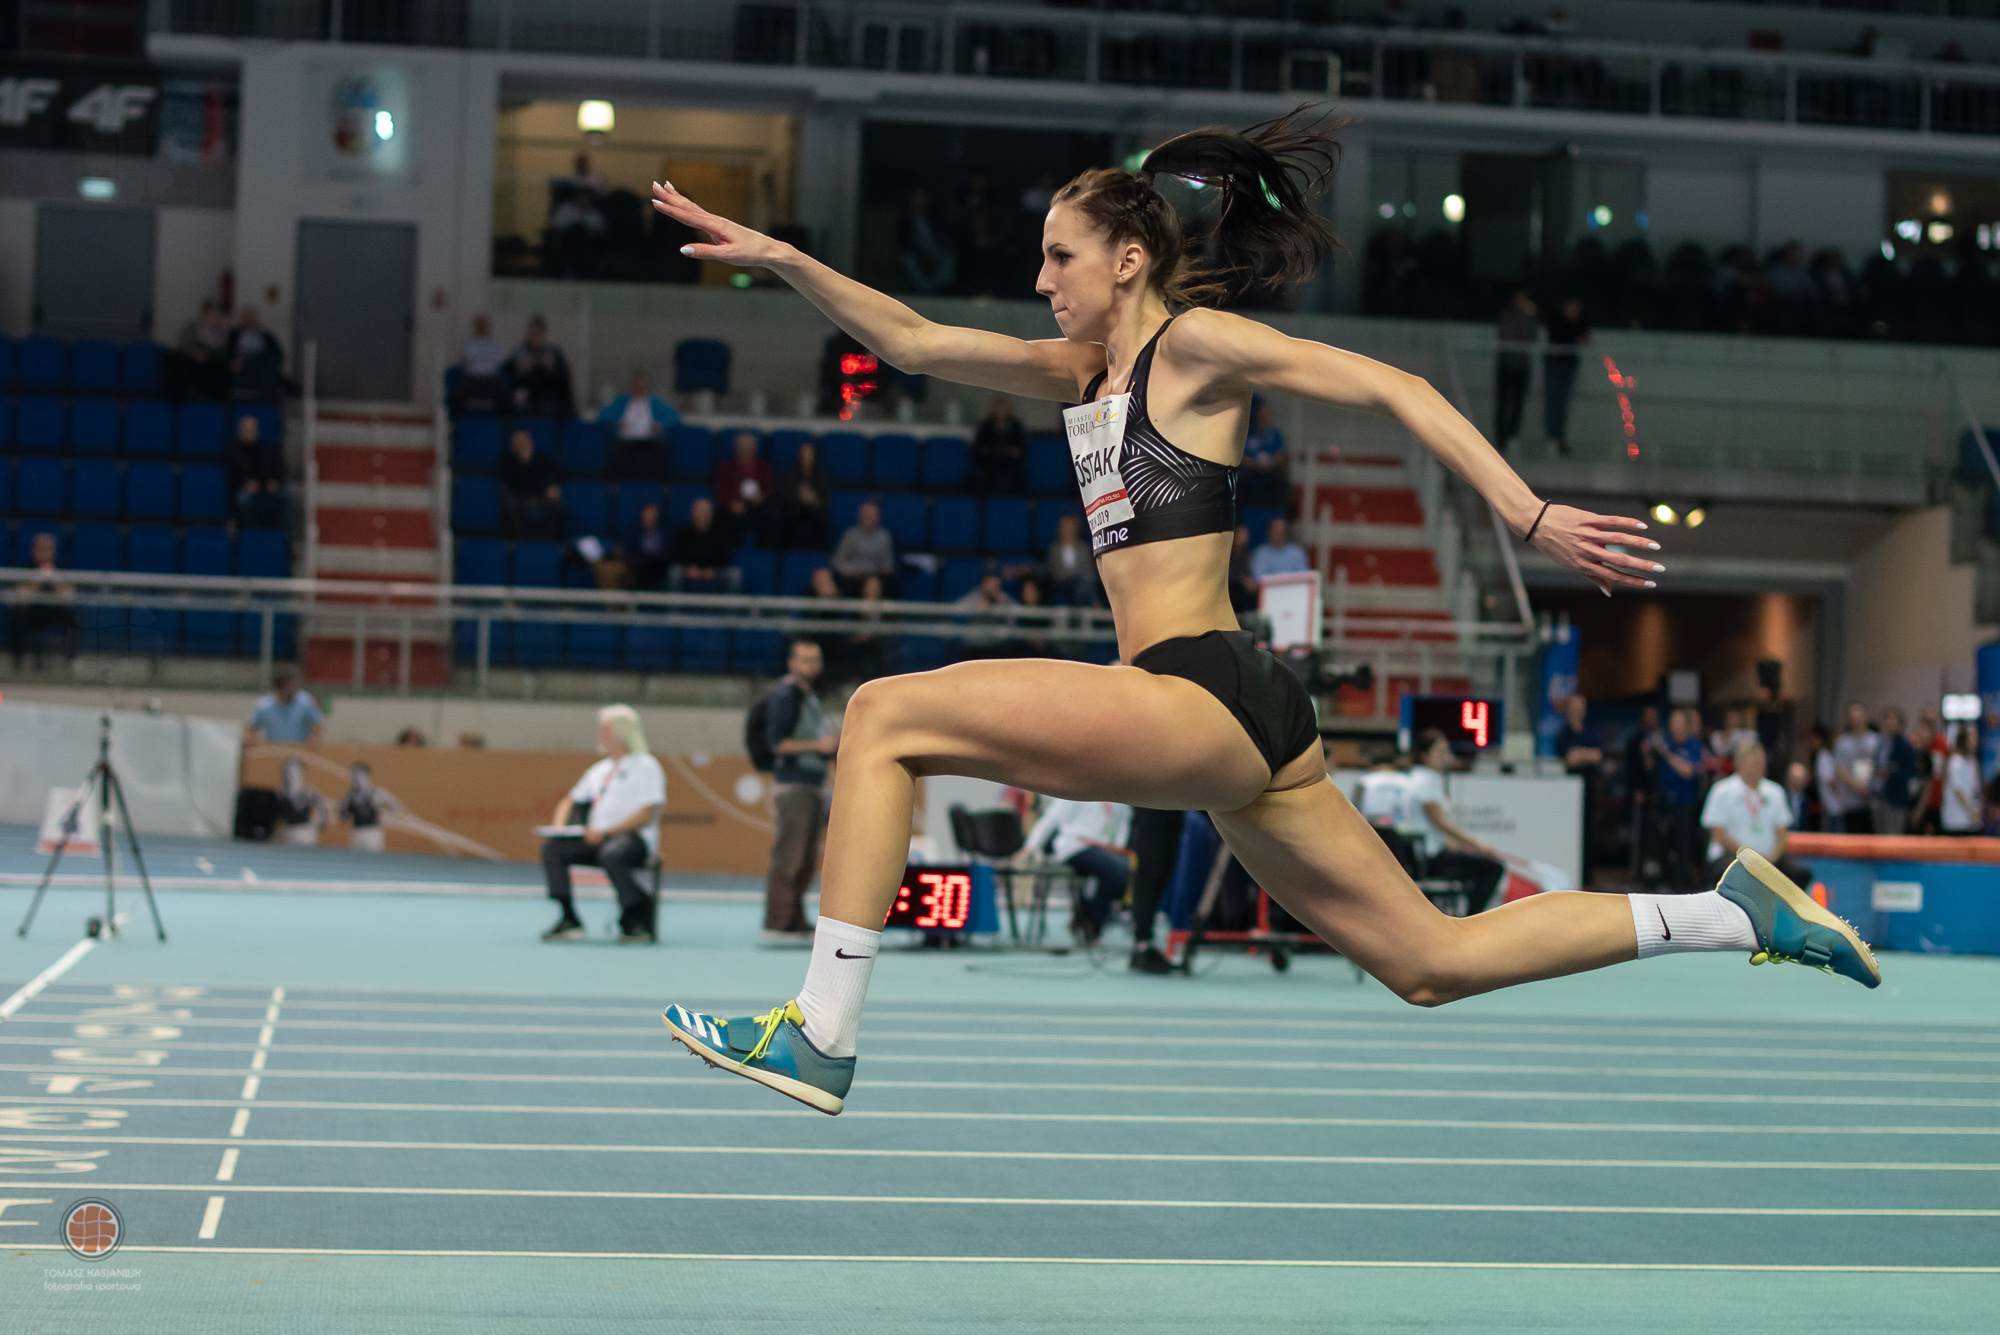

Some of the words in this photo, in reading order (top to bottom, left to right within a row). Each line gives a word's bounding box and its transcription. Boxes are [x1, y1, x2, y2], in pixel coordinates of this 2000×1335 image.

[67, 84, 157, 134] 4F
[1068, 414, 1091, 424] MIASTO
[1461, 701, 1489, 747] 4
[884, 873, 971, 928] :30
